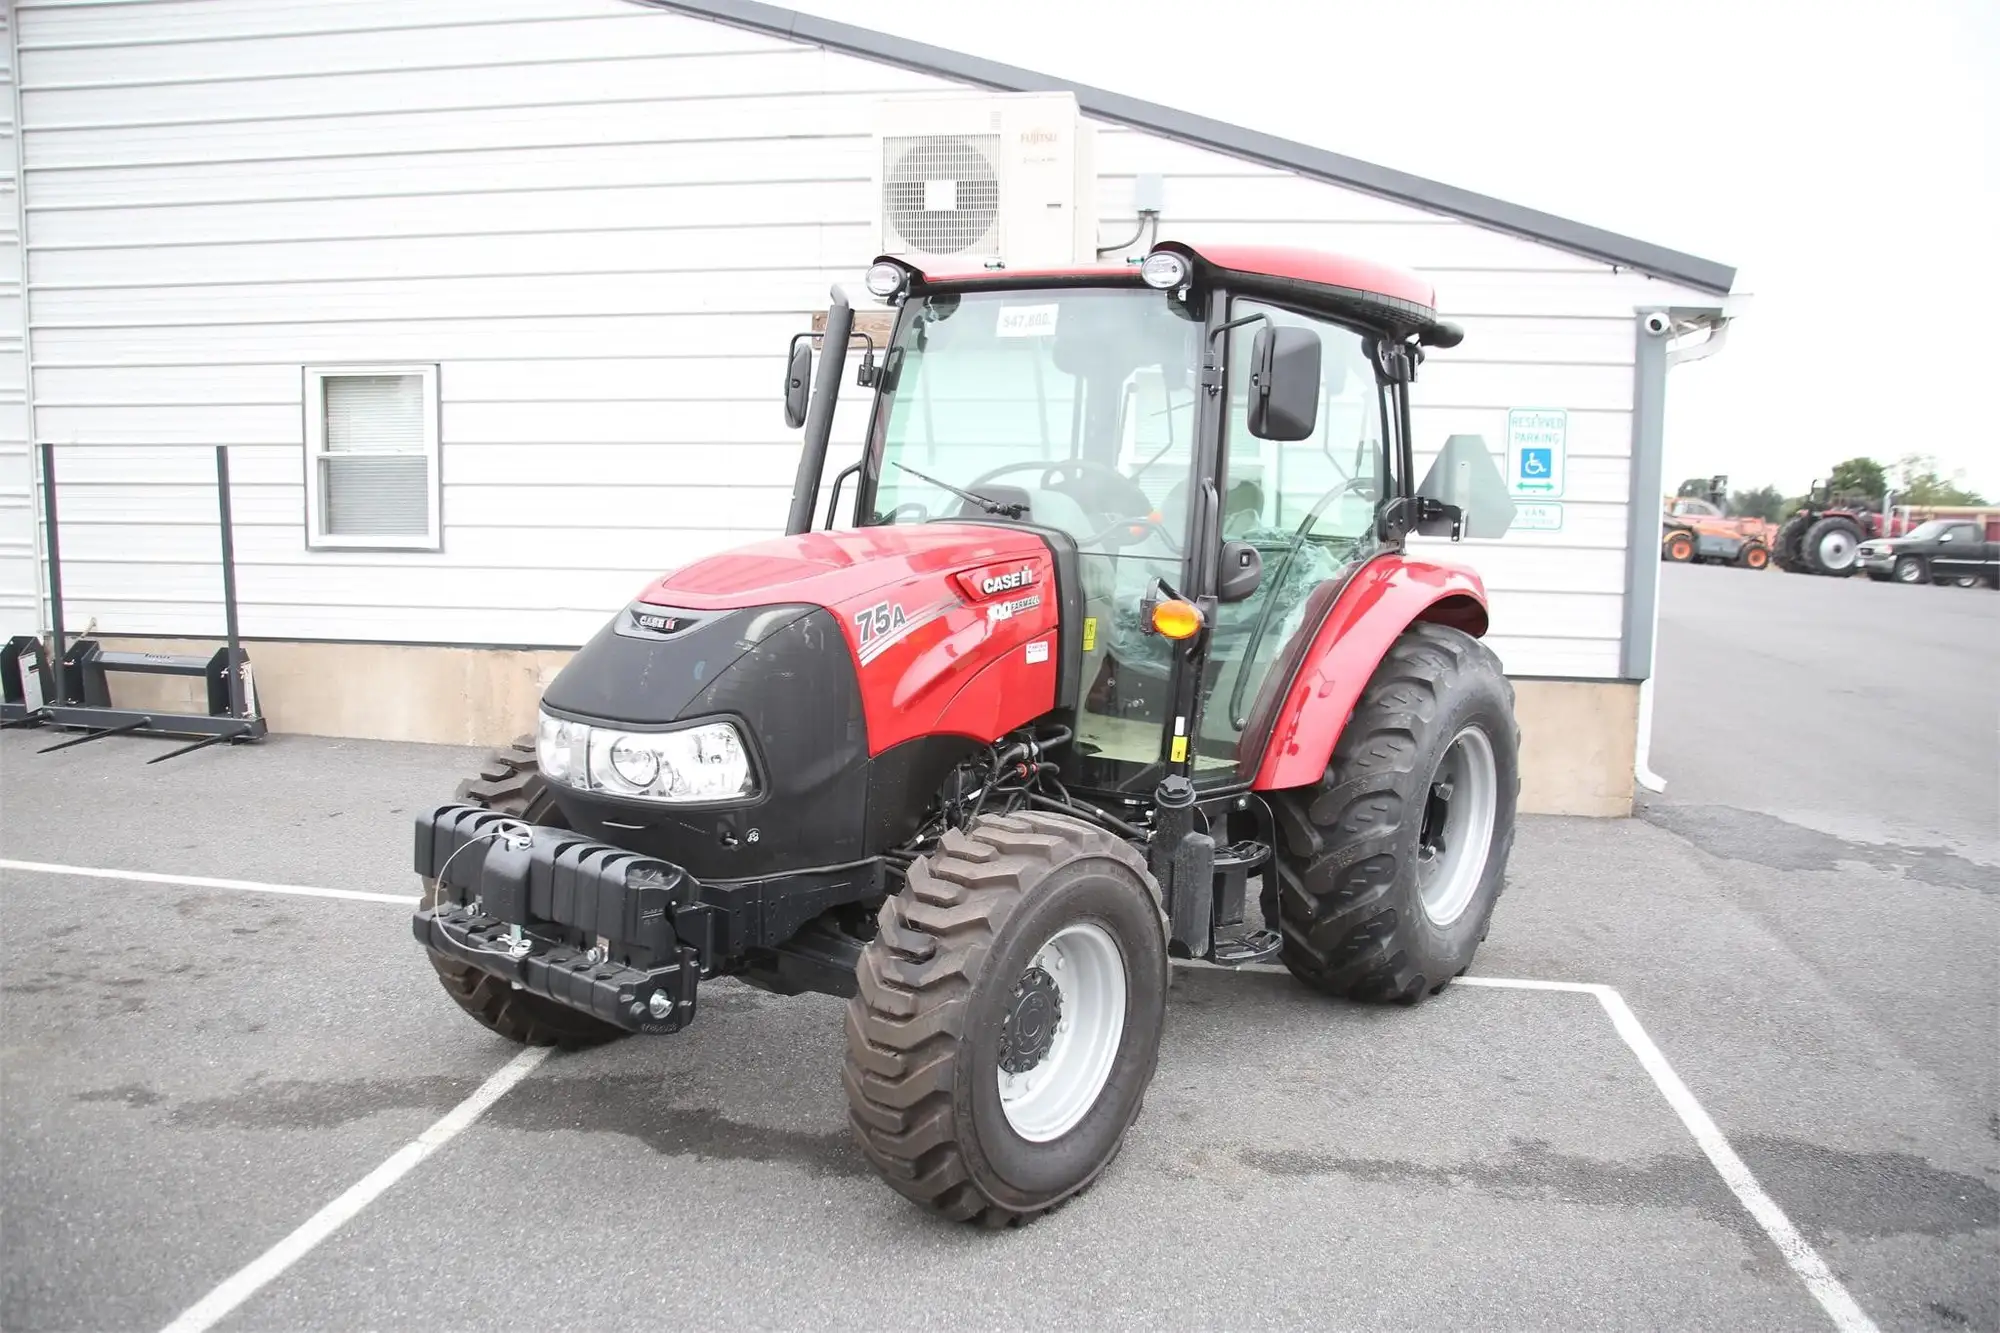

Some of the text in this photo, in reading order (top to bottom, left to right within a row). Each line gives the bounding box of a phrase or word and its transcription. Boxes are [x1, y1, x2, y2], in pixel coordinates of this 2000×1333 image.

[1020, 130, 1057, 145] FUJITSU
[1512, 417, 1564, 429] RESERVED
[1515, 431, 1560, 444] PARKING
[1524, 508, 1546, 517] VAN
[983, 572, 1020, 594] CASE
